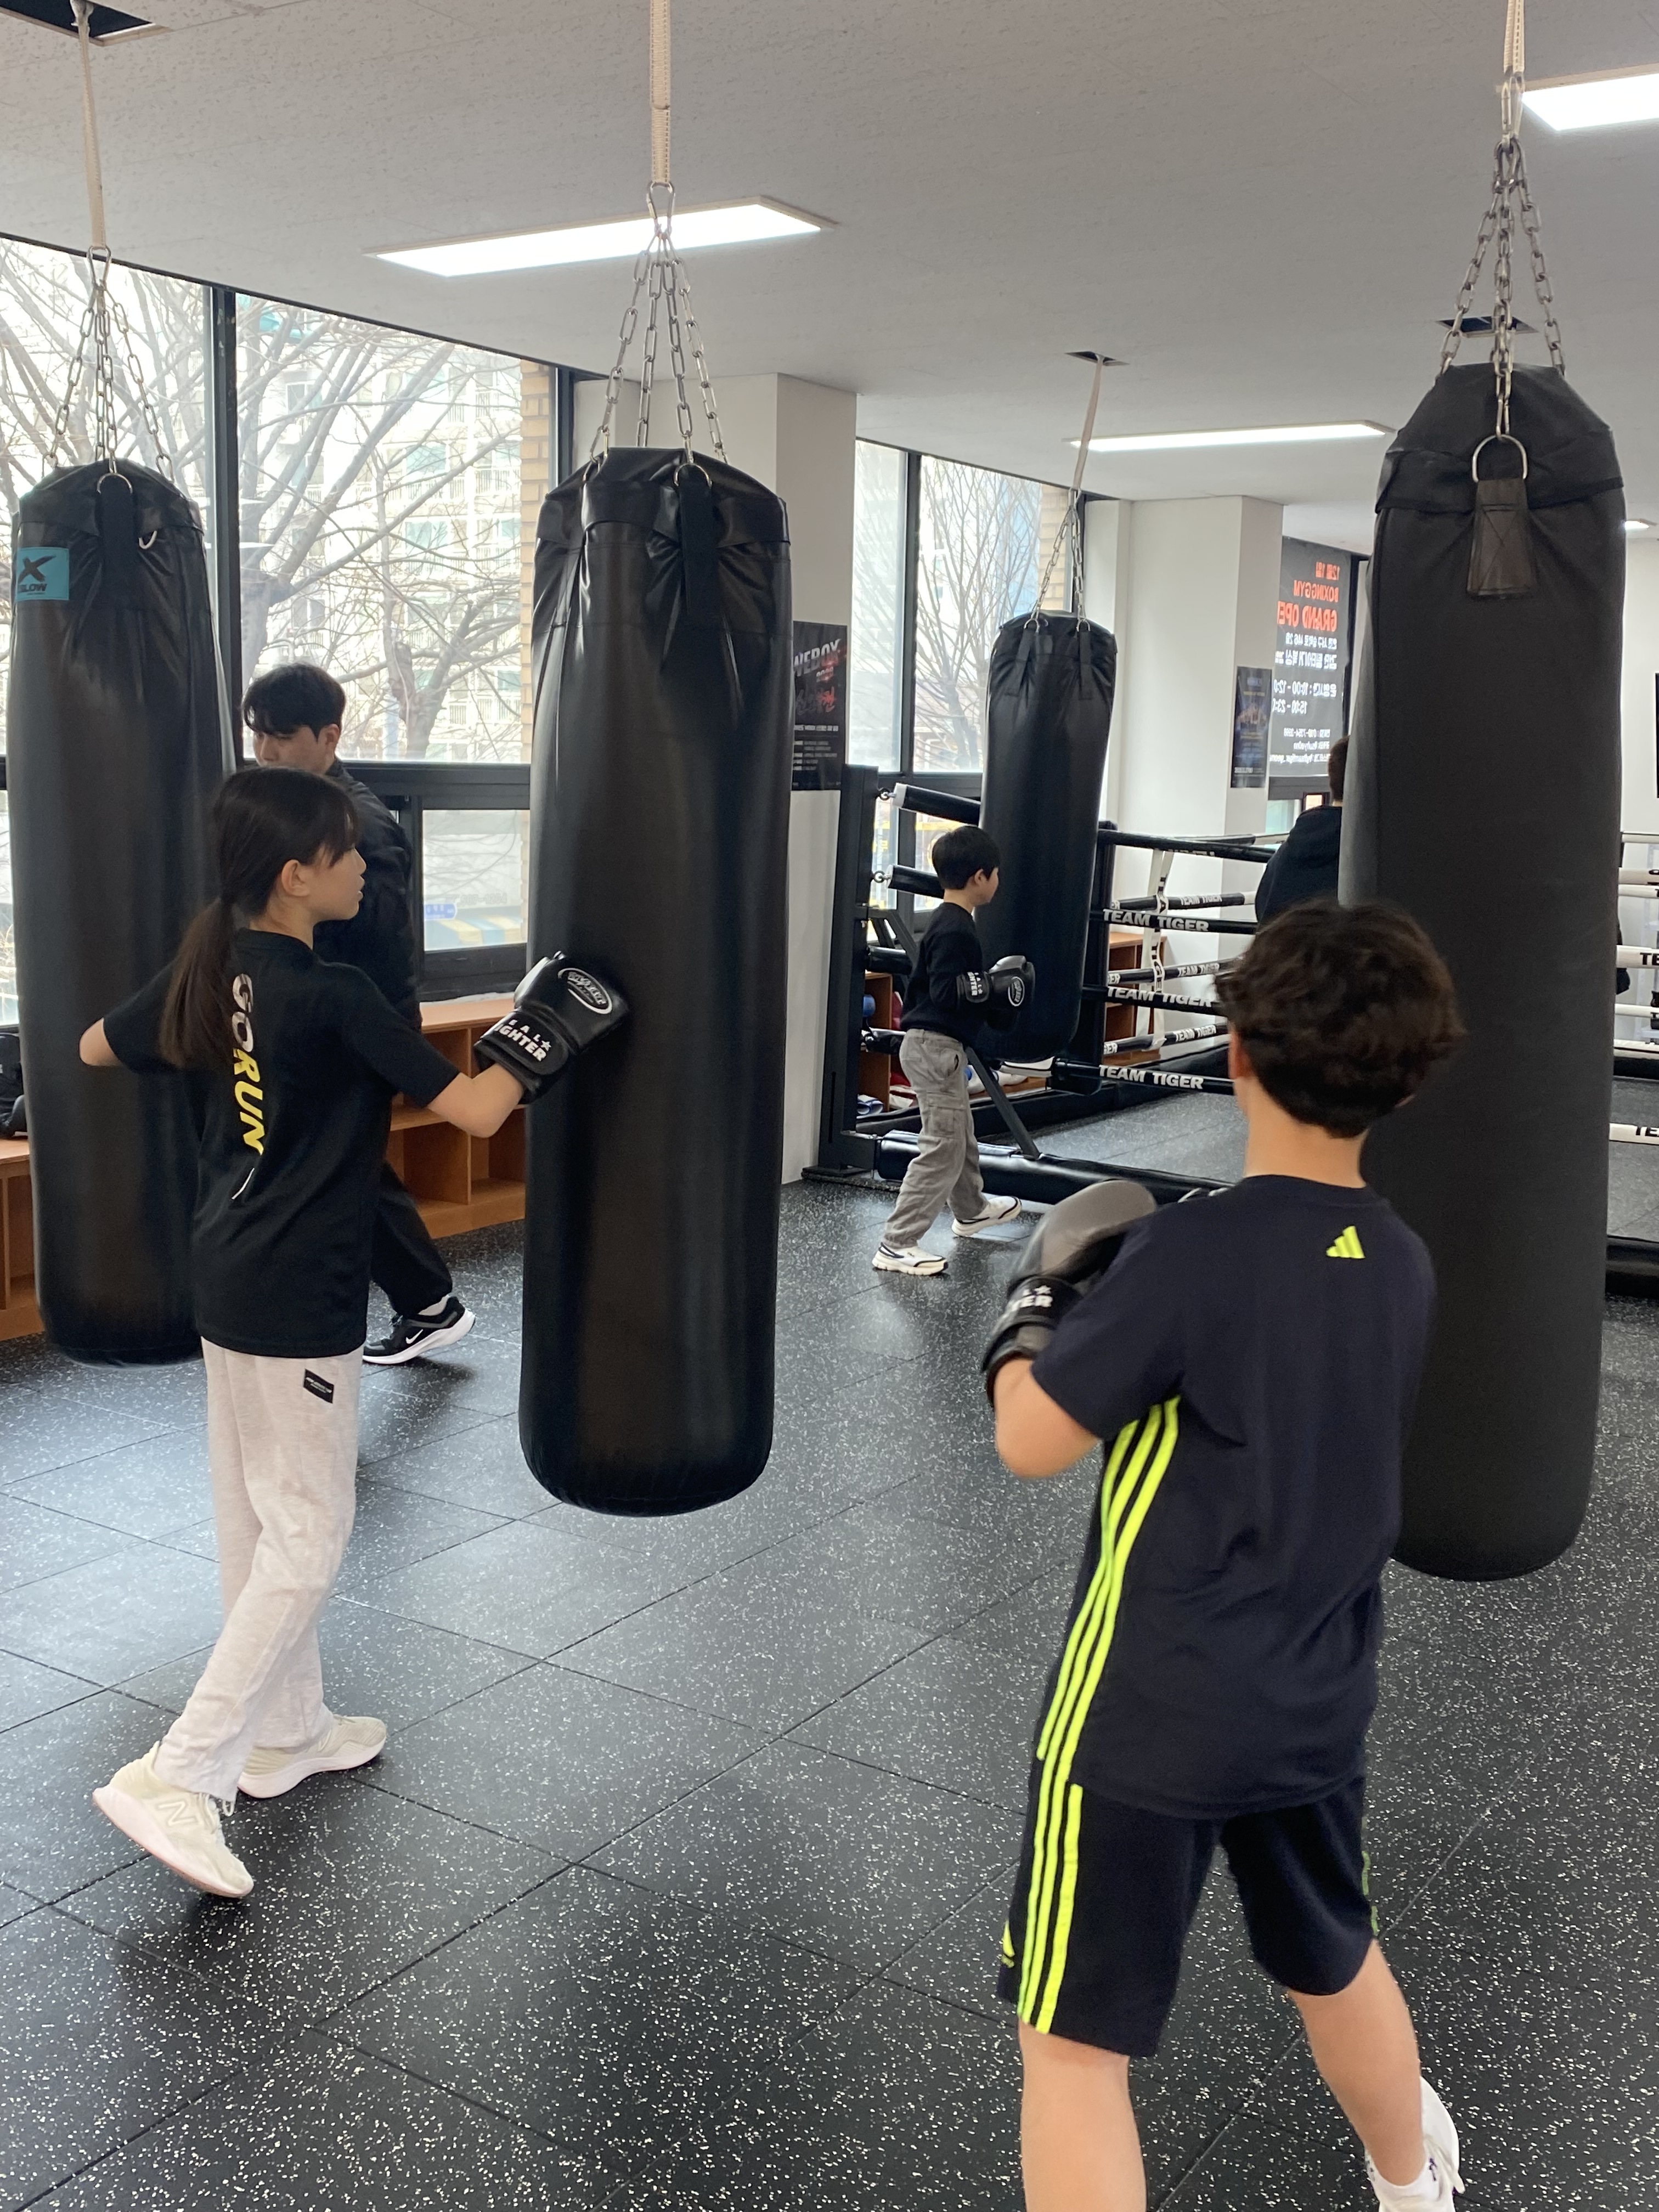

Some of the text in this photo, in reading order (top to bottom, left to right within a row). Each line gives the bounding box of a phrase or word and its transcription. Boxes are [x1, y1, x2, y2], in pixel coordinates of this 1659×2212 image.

[1180, 894, 1222, 905] TEAM TIGER
[1103, 909, 1209, 932] TEAM TIGER
[1177, 966, 1198, 977] TEAM
[1108, 987, 1212, 1007] TEAM TIGER
[1173, 1029, 1195, 1042] TEAM
[1099, 1064, 1204, 1090] TEAM TIGER
